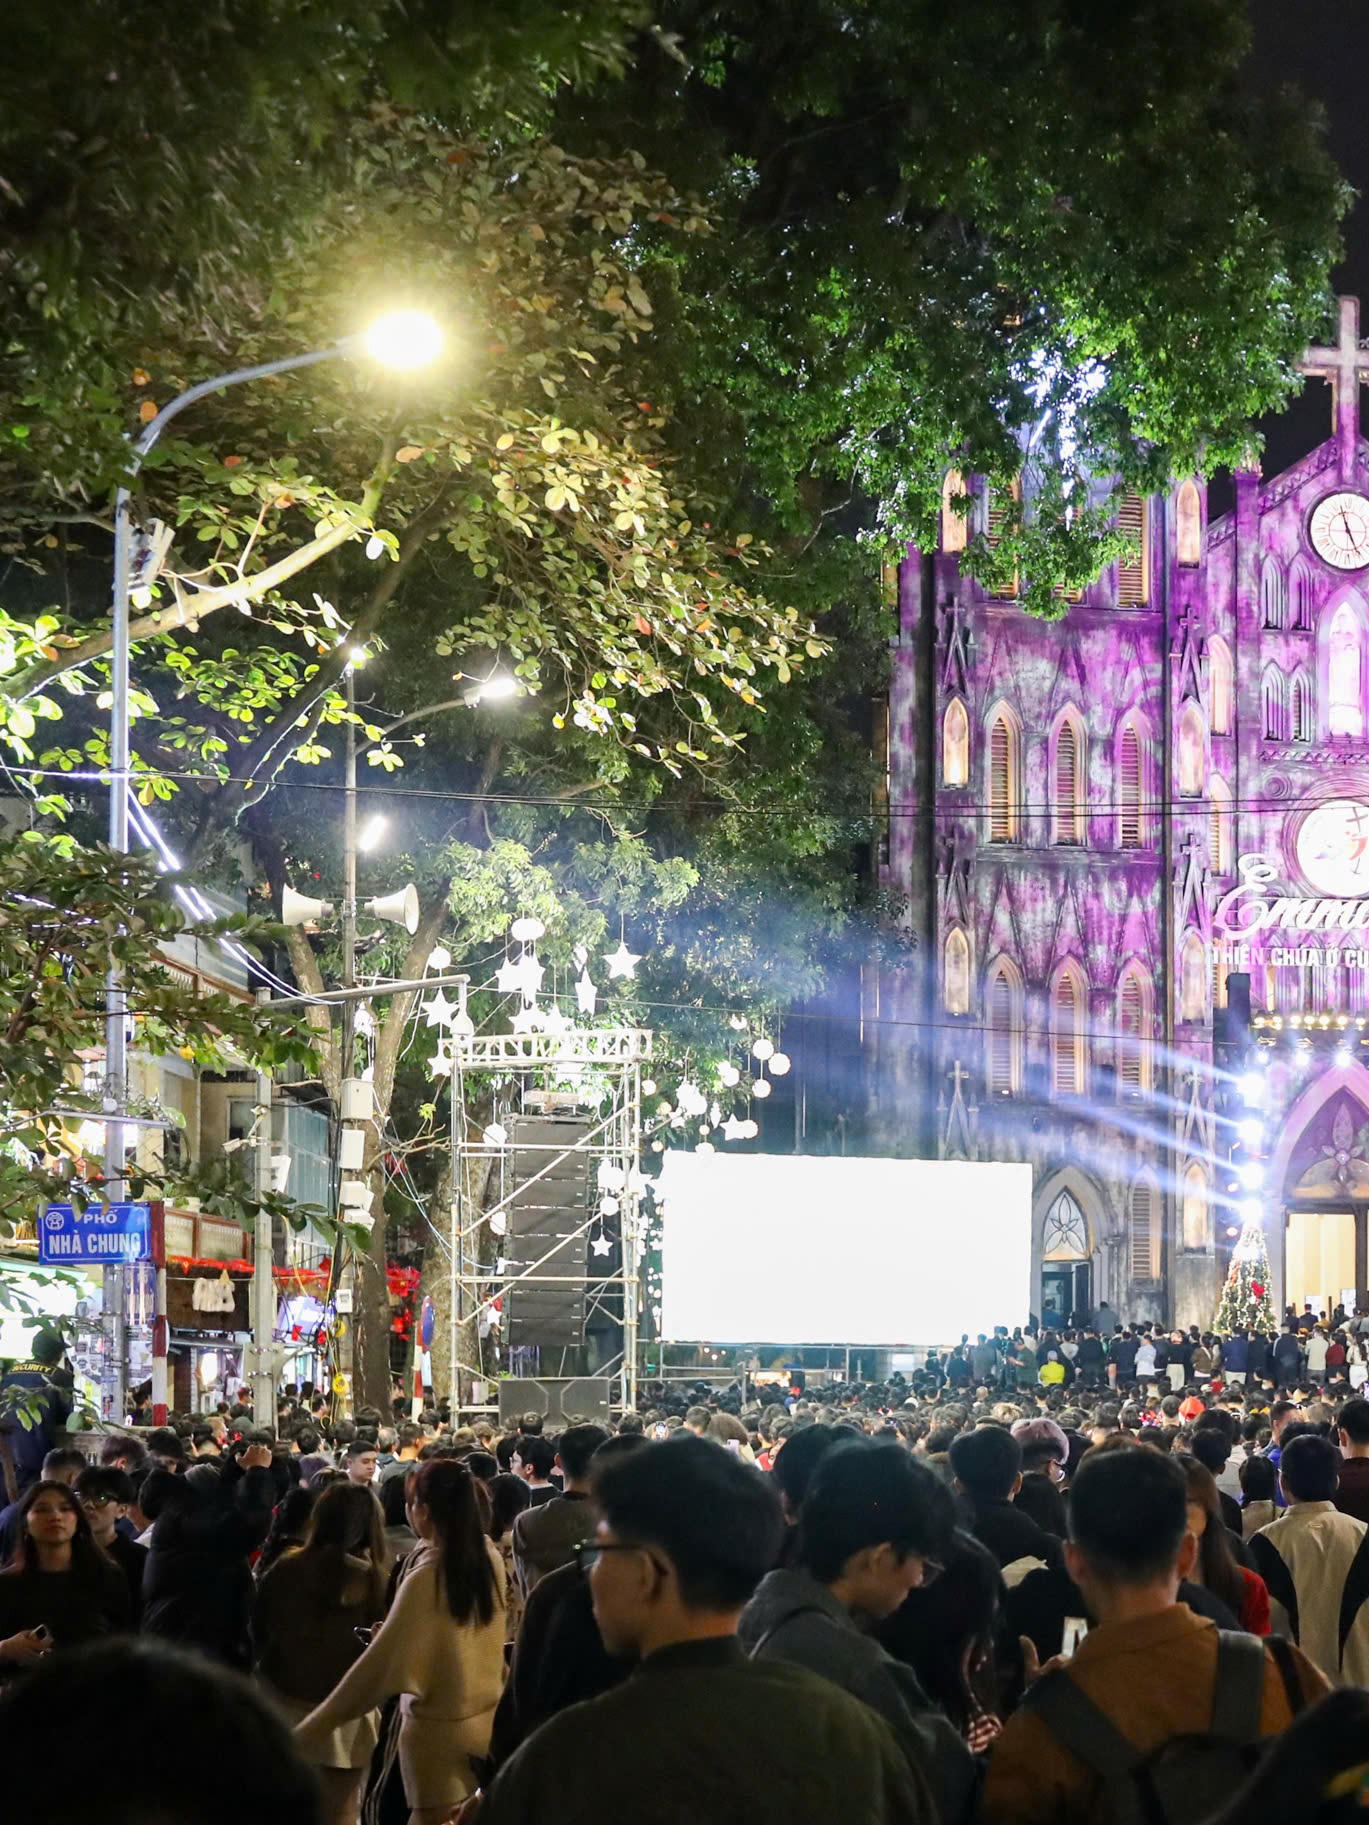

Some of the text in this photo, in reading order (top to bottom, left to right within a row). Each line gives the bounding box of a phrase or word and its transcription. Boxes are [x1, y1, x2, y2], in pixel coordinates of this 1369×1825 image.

[1210, 943, 1265, 965] THIÊN
[84, 1209, 118, 1224] PHỐ
[48, 1229, 141, 1254] NHÀ CHUNG
